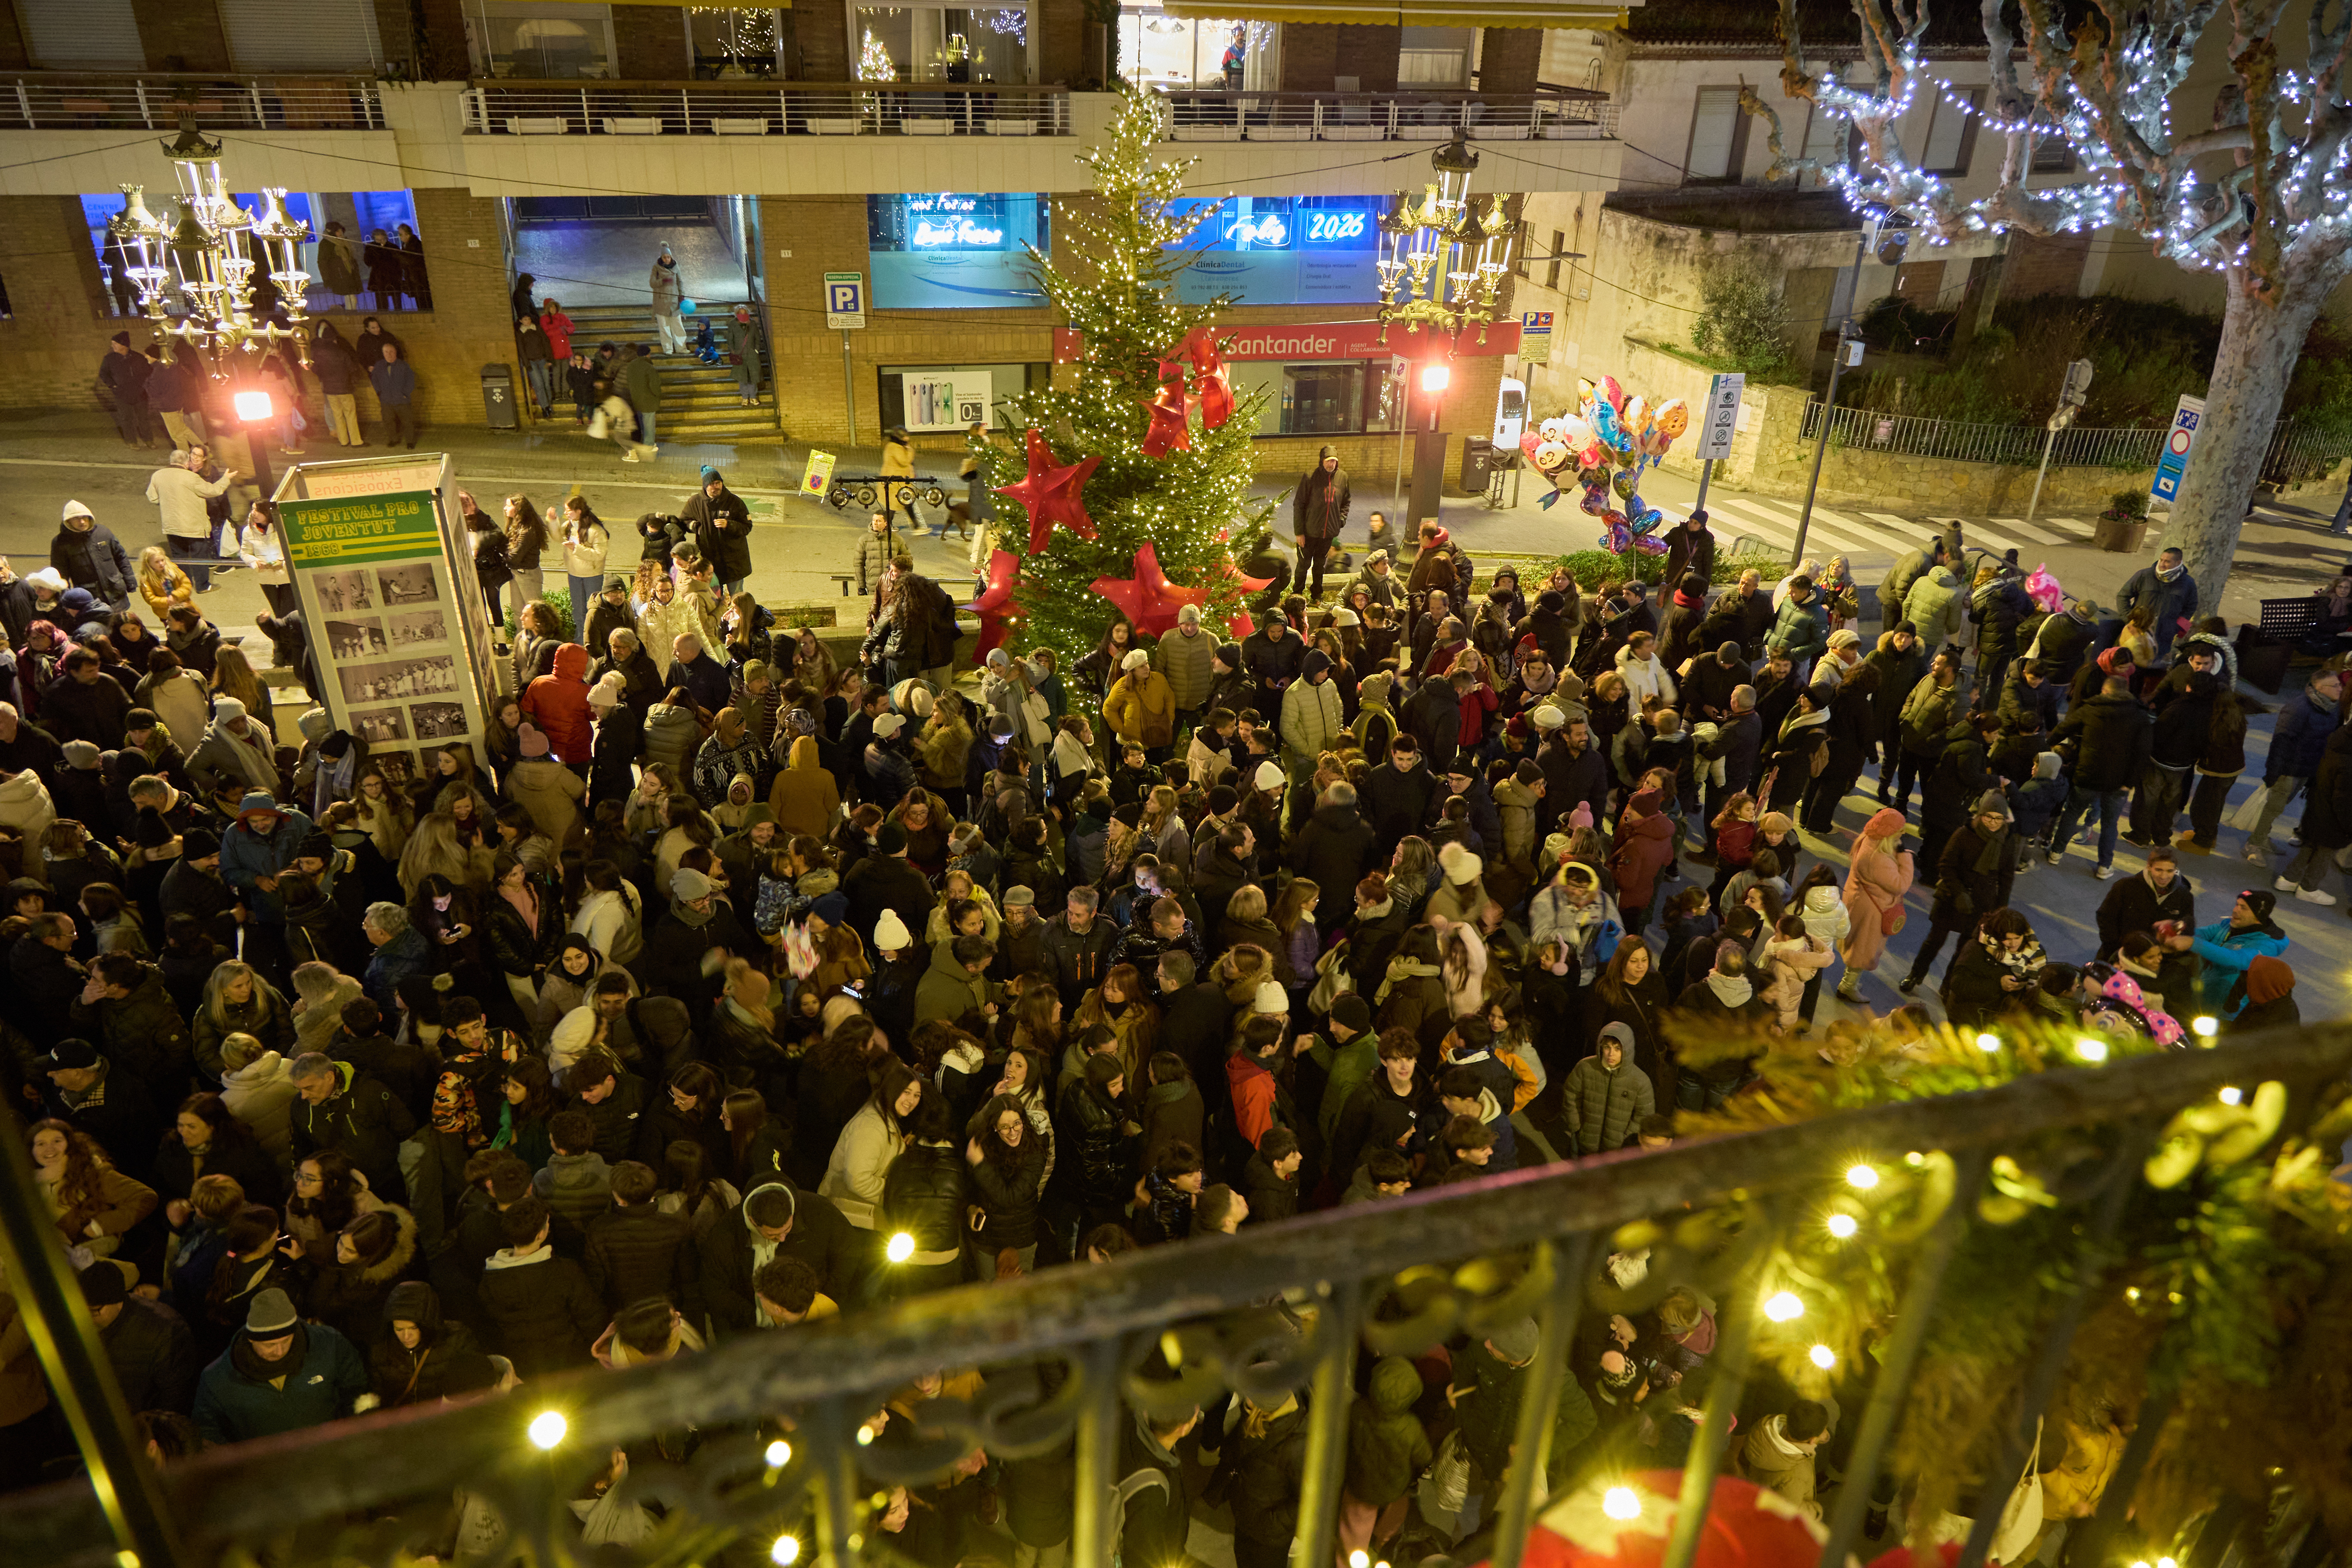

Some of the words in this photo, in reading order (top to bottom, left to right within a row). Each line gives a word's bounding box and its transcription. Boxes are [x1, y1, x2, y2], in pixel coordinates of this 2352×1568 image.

[1310, 213, 1365, 239] 2026
[835, 287, 854, 309] P
[1526, 312, 1536, 326] P
[1225, 334, 1336, 355] Santander
[962, 404, 972, 420] 0
[296, 504, 384, 525] FESTIVAL
[385, 500, 420, 517] PRO
[302, 519, 396, 541] JOVENTUT
[305, 542, 340, 557] 1968
